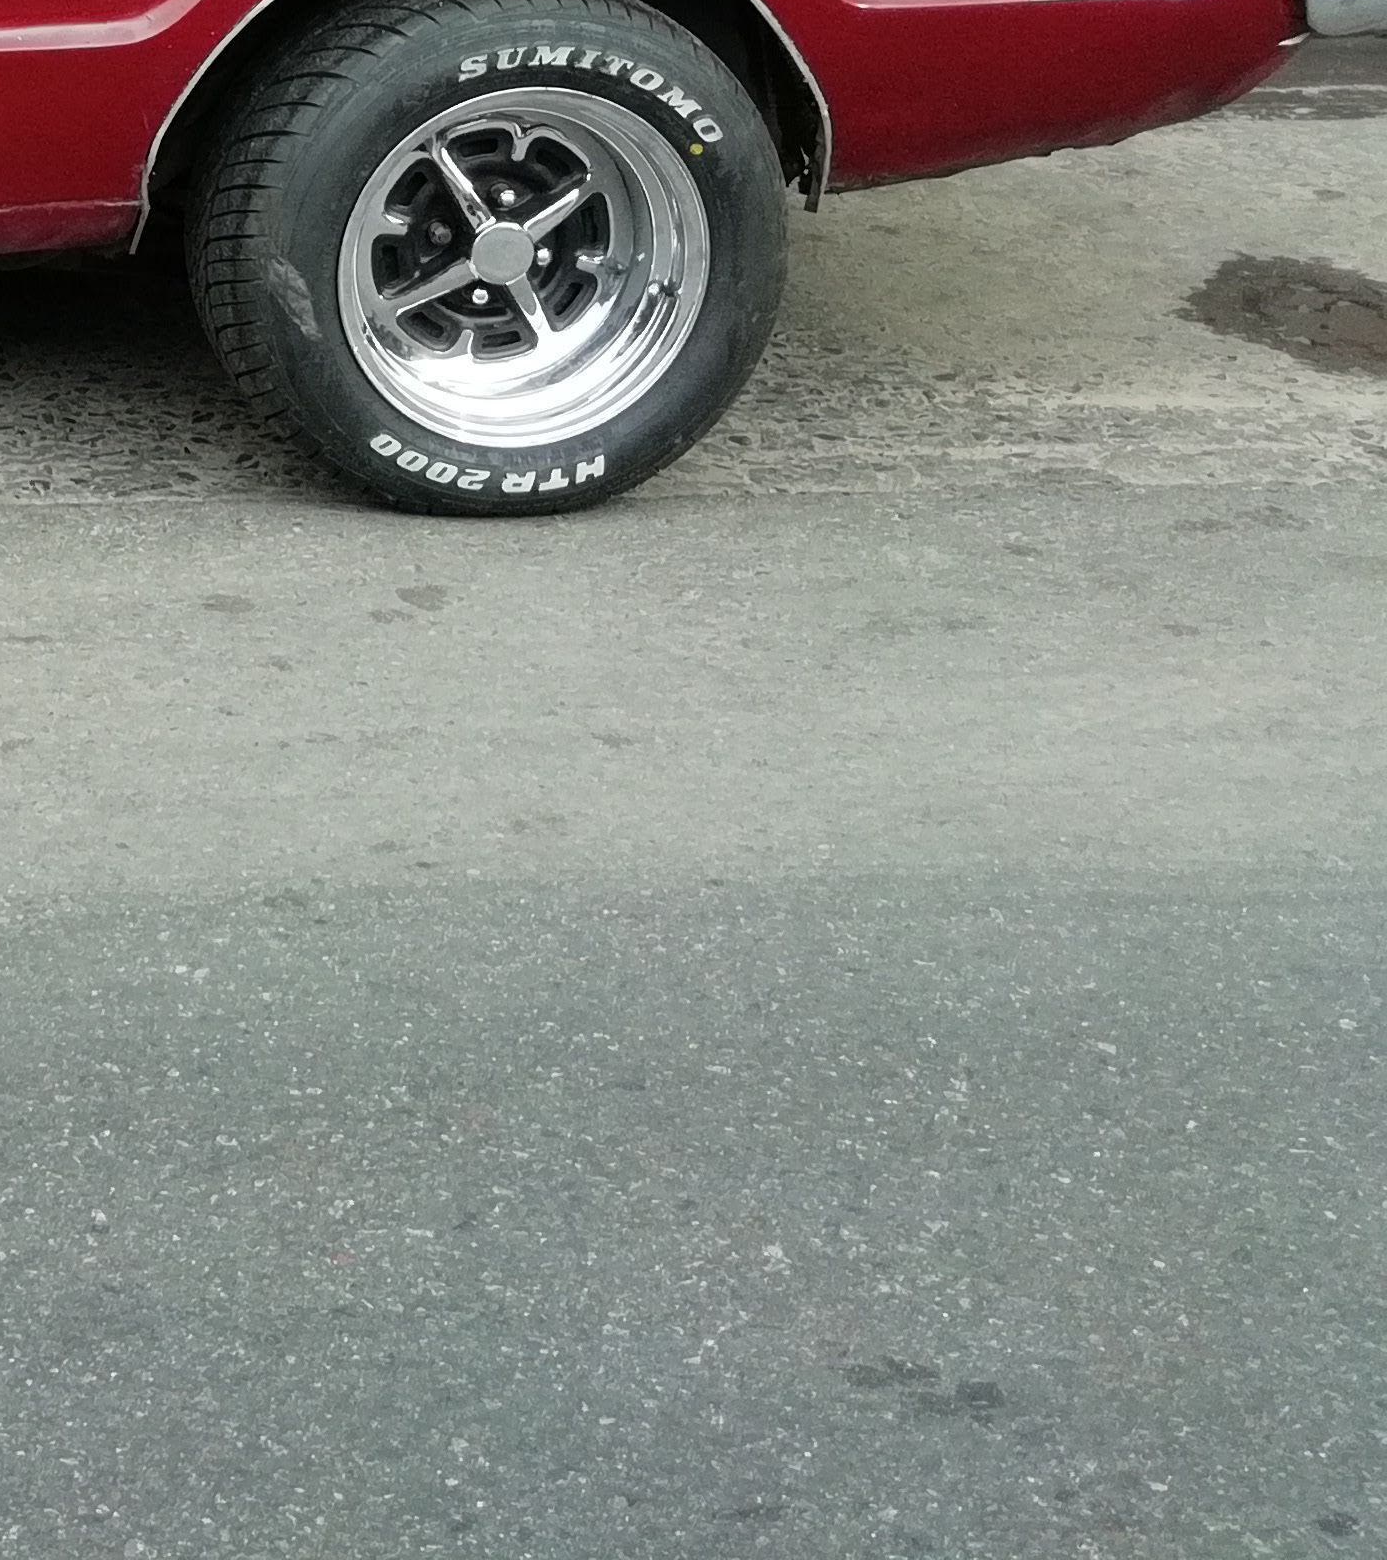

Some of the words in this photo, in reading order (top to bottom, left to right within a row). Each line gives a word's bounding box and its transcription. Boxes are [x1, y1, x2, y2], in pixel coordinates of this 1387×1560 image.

[458, 45, 724, 142] SUMITOMO
[369, 433, 491, 491] 2000
[501, 454, 605, 493] HTR
